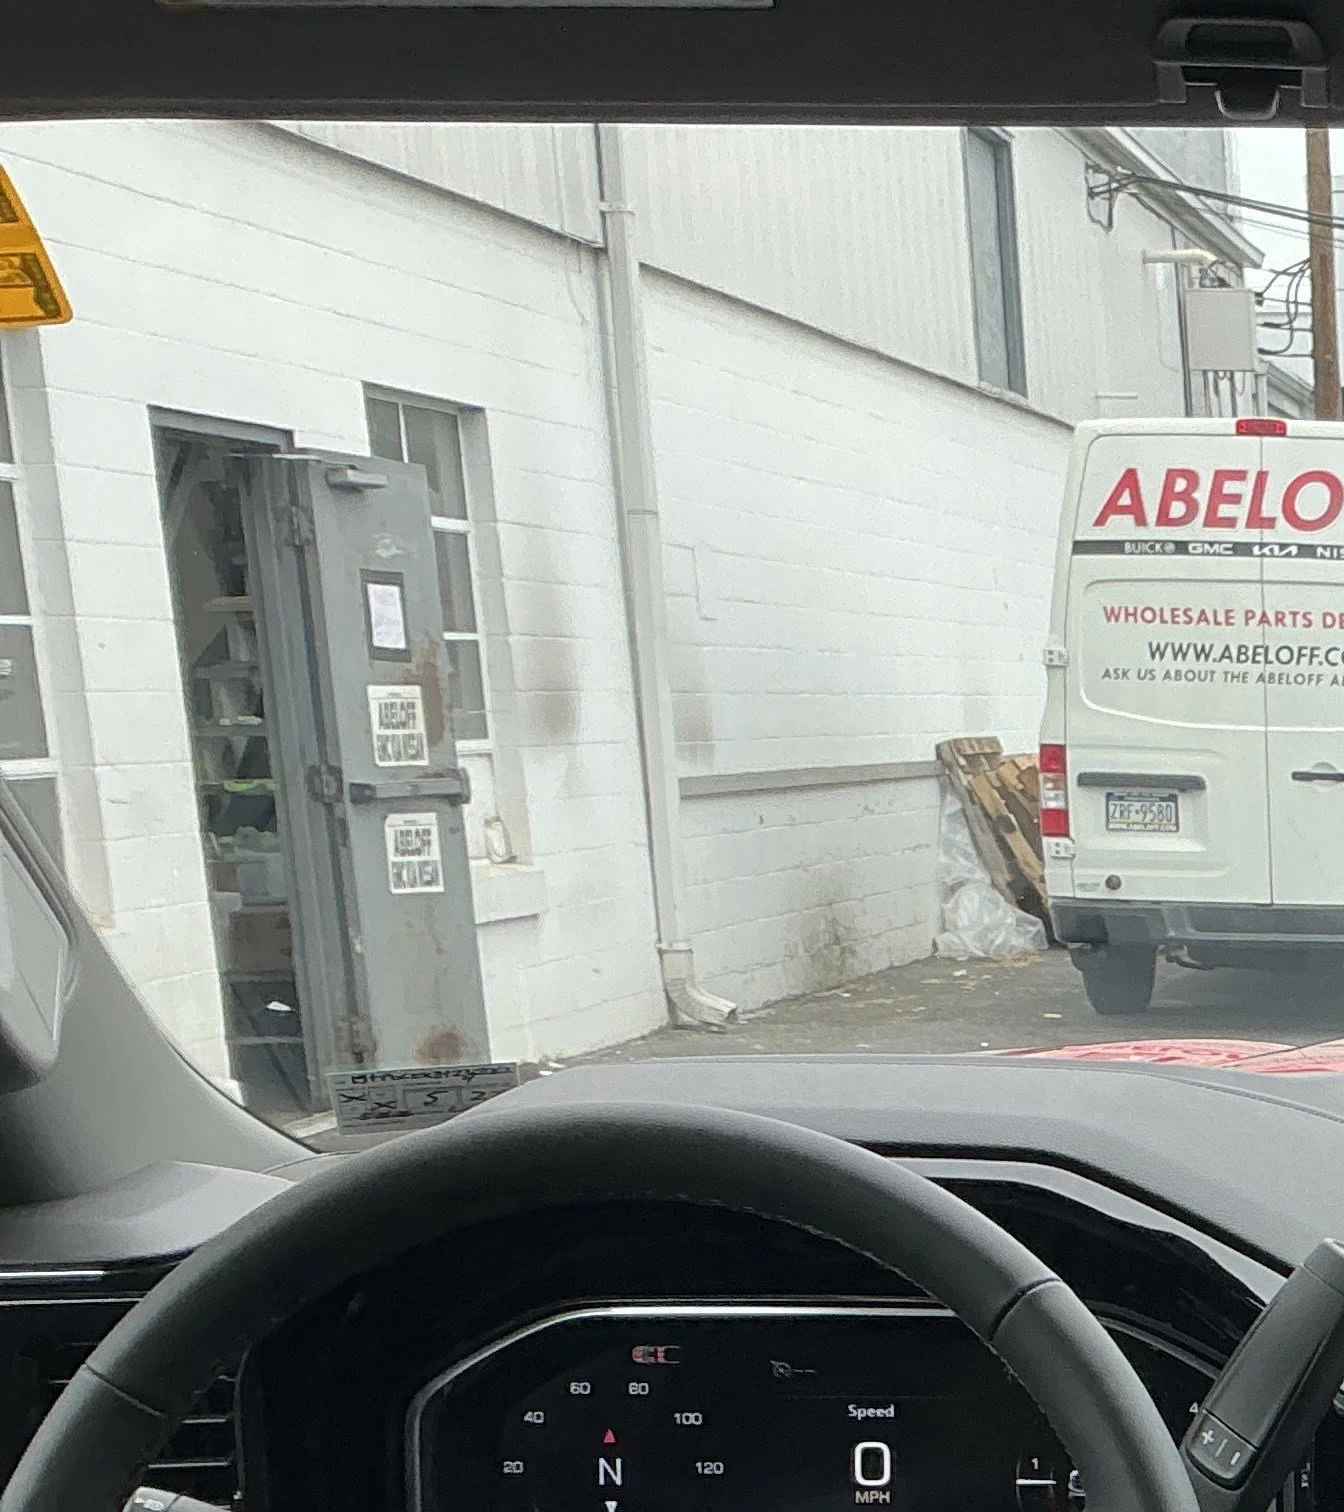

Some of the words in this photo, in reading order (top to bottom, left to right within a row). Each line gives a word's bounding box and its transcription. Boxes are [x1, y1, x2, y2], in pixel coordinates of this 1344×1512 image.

[1123, 541, 1163, 555] BUICK
[1188, 542, 1234, 556] GMC
[1102, 605, 1236, 627] WHOLESALE
[1244, 608, 1314, 630] PARTS
[1101, 667, 1131, 681] ASK
[1137, 668, 1157, 682] US
[1162, 669, 1216, 683] ABOUT
[1223, 671, 1249, 684] THE
[1256, 671, 1324, 687] ABELOFF
[523, 1411, 545, 1424] 40
[674, 1412, 703, 1426] 100
[848, 1404, 895, 1420] Speed
[503, 1461, 524, 1474] 20
[695, 1461, 724, 1475] 120
[854, 1441, 891, 1486] 0
[598, 1457, 623, 1486] N
[855, 1490, 891, 1504] MPH
